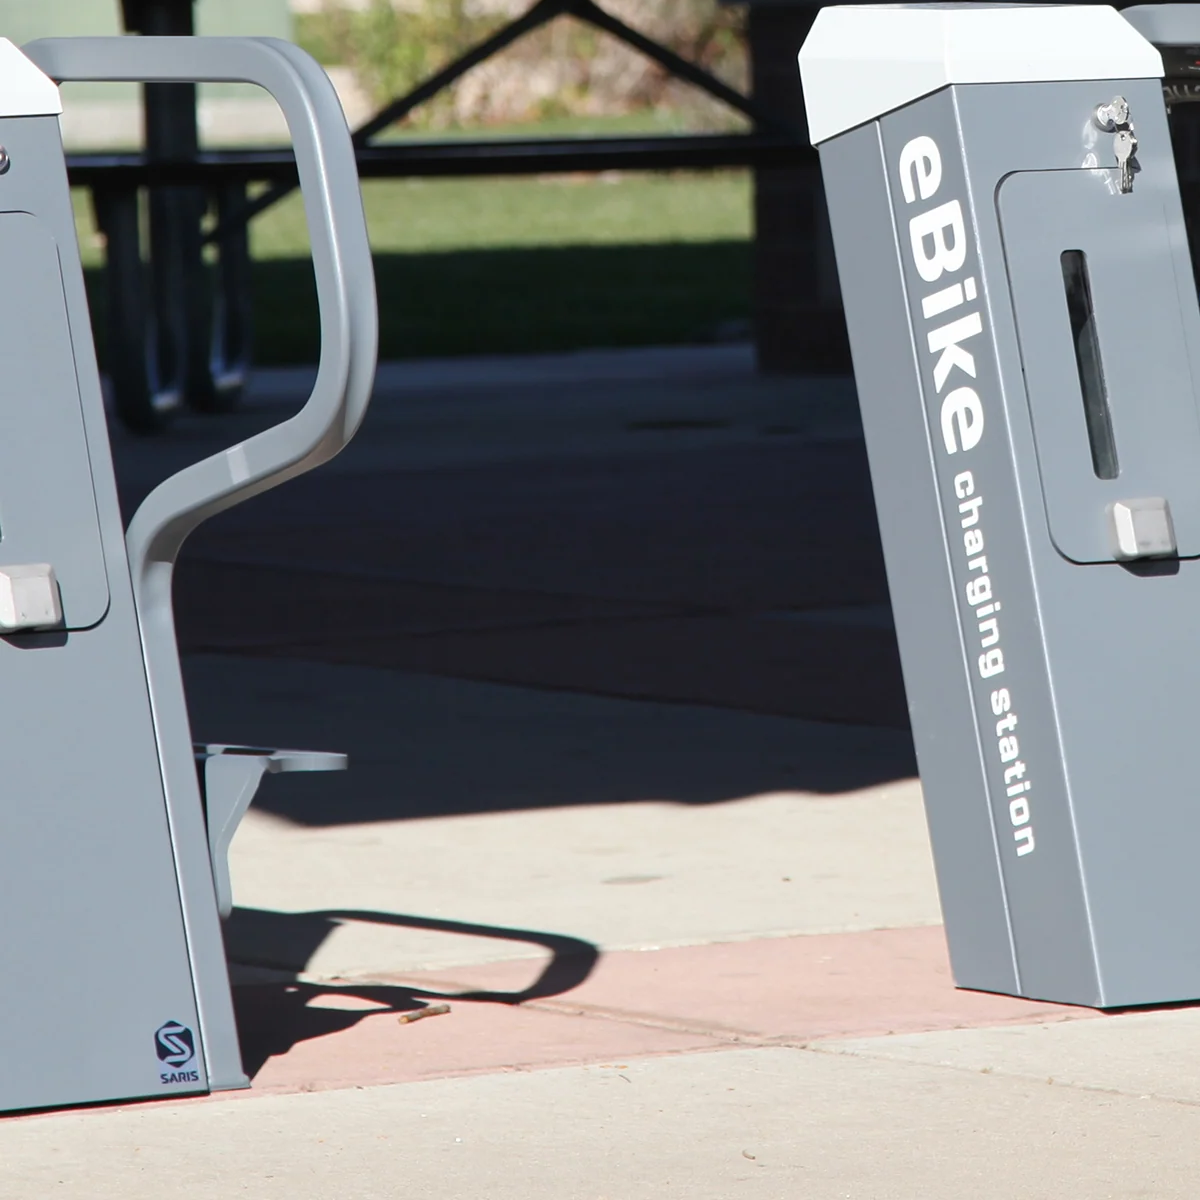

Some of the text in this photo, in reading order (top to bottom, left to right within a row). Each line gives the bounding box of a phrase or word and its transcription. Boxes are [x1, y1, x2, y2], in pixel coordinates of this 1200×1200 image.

[899, 135, 1036, 858] eBike charging station
[160, 1070, 199, 1084] SARIS
